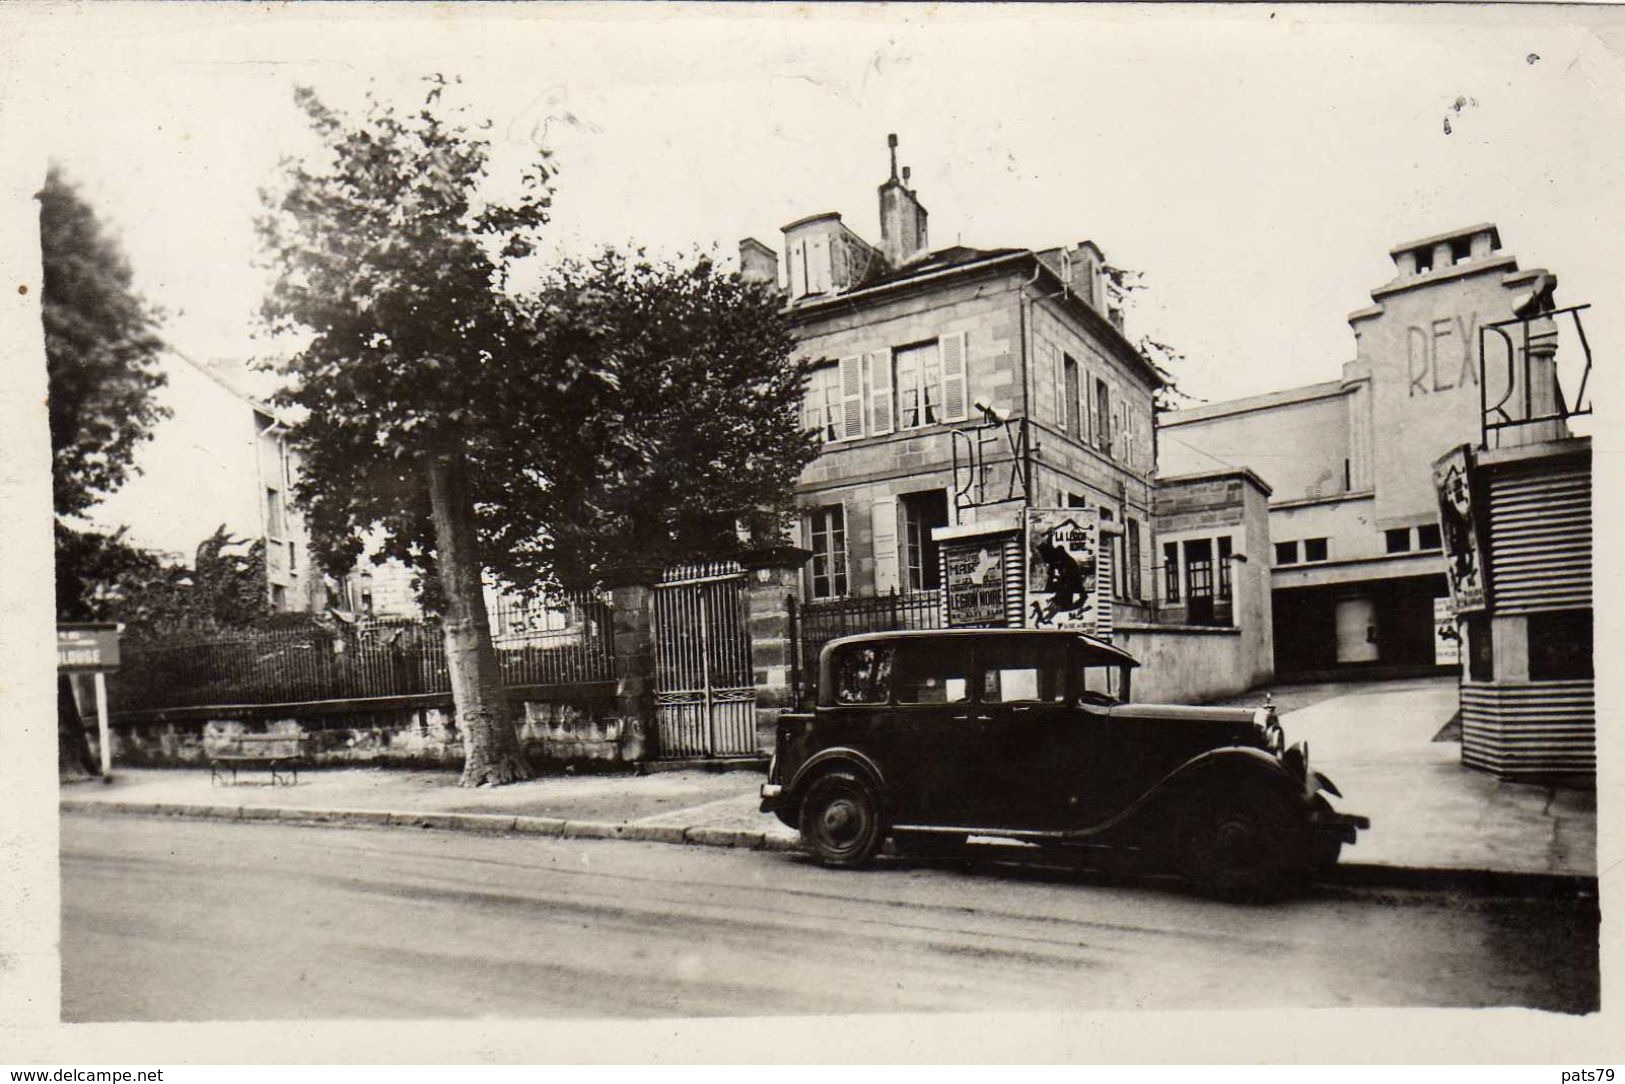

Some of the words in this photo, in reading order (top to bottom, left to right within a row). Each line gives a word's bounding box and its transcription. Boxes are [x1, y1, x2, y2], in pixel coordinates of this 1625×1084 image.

[1406, 311, 1479, 398] REX
[951, 420, 1027, 508] REX
[1055, 531, 1064, 542] LA
